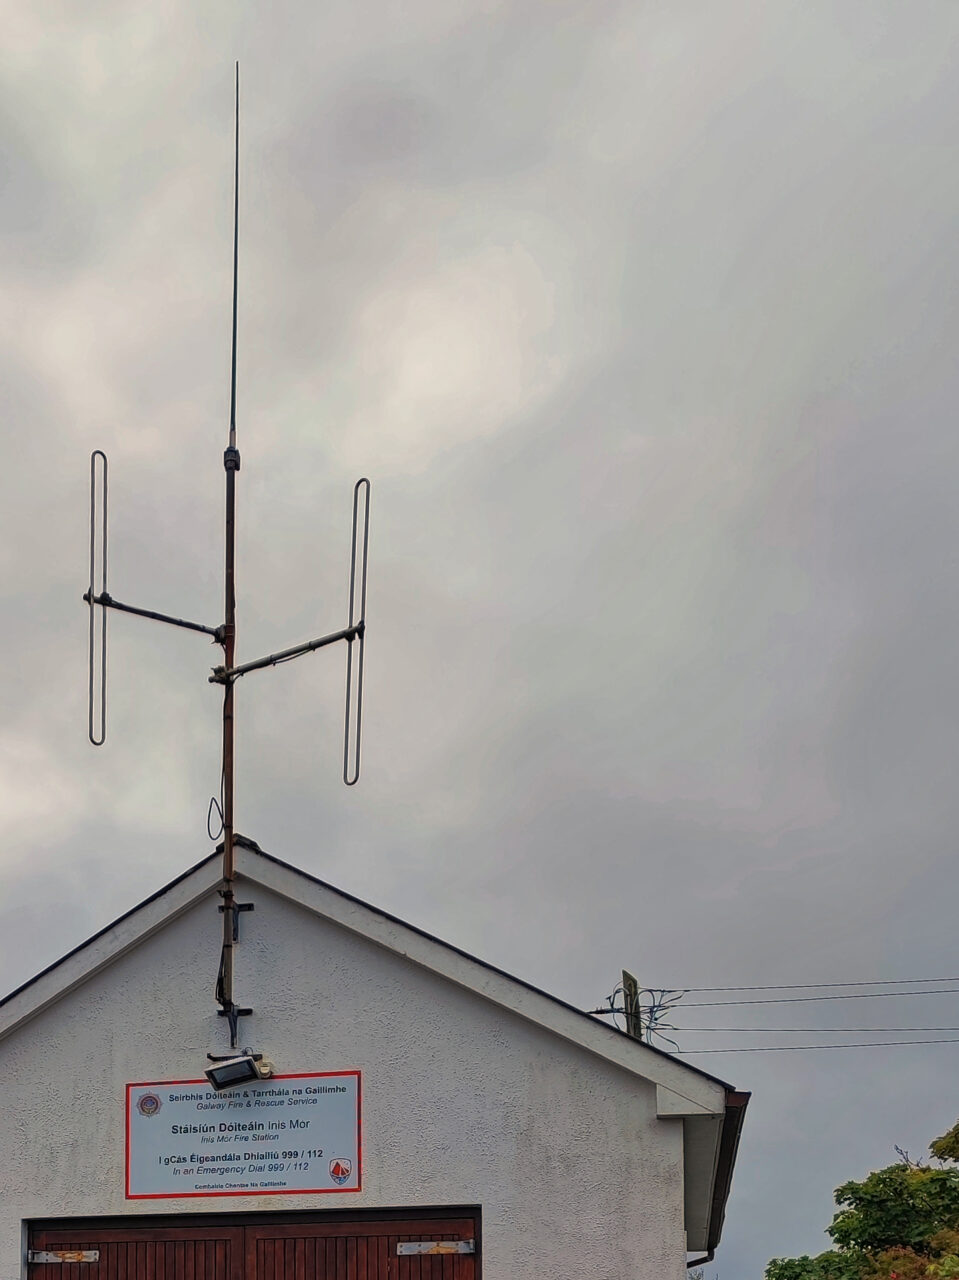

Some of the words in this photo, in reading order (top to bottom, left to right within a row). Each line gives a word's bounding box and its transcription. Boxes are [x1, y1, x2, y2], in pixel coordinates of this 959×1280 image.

[243, 1090, 249, 1098] &
[305, 1085, 347, 1095] Gaillimhe
[196, 1102, 226, 1111] Galway
[228, 1100, 244, 1109] Fire
[254, 1099, 285, 1107] Rescue
[287, 1097, 318, 1106] Service
[219, 1120, 265, 1132] Dóiteáin
[268, 1119, 287, 1130] Inis
[200, 1135, 215, 1144] Inis
[234, 1134, 250, 1142] Fire
[251, 1133, 280, 1142] Station
[281, 1150, 299, 1159] 999
[307, 1149, 324, 1158] 112
[172, 1167, 181, 1176] In
[196, 1165, 246, 1176] Emergency
[248, 1163, 266, 1173] Dial
[267, 1163, 285, 1172] 999
[286, 1163, 292, 1171] /
[294, 1162, 310, 1171] 112
